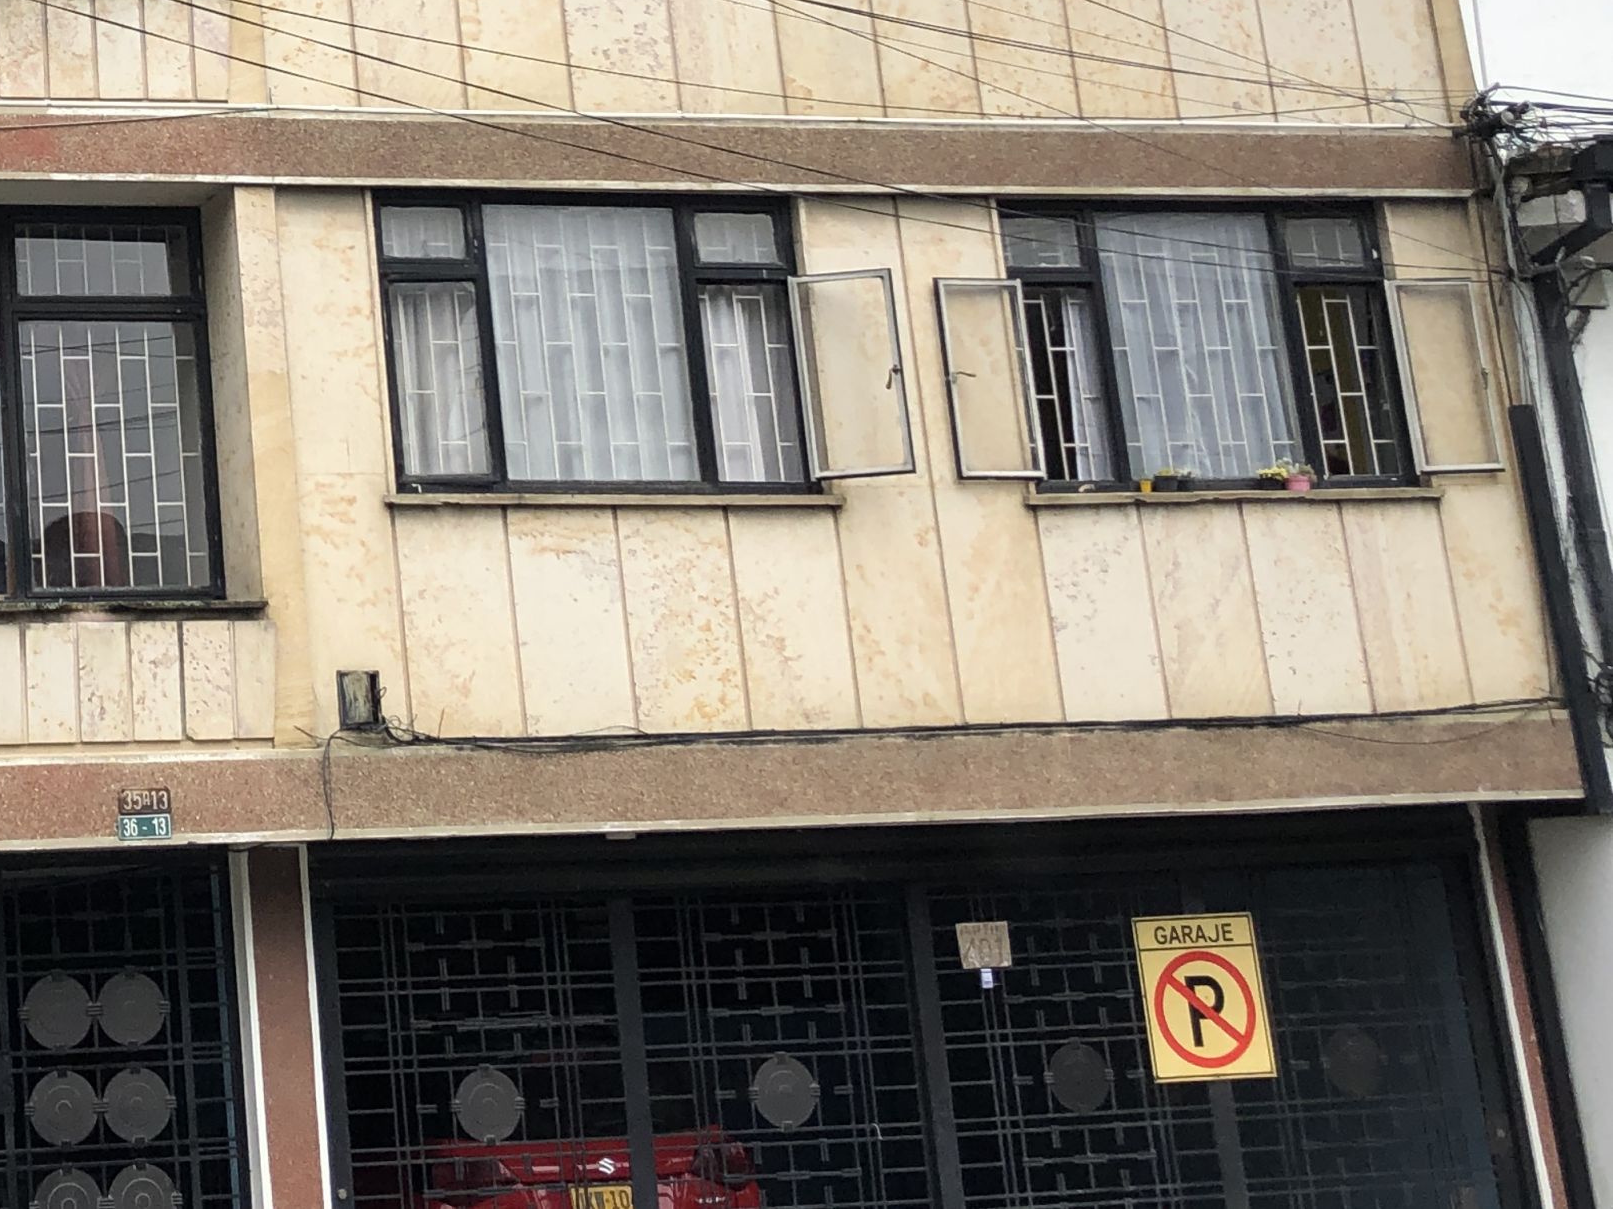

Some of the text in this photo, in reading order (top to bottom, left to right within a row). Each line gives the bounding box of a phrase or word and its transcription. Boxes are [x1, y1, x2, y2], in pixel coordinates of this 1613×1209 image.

[122, 818, 138, 837] 36
[151, 817, 167, 836] 13
[1153, 922, 1235, 945] GARAJE
[1184, 975, 1225, 1048] P
